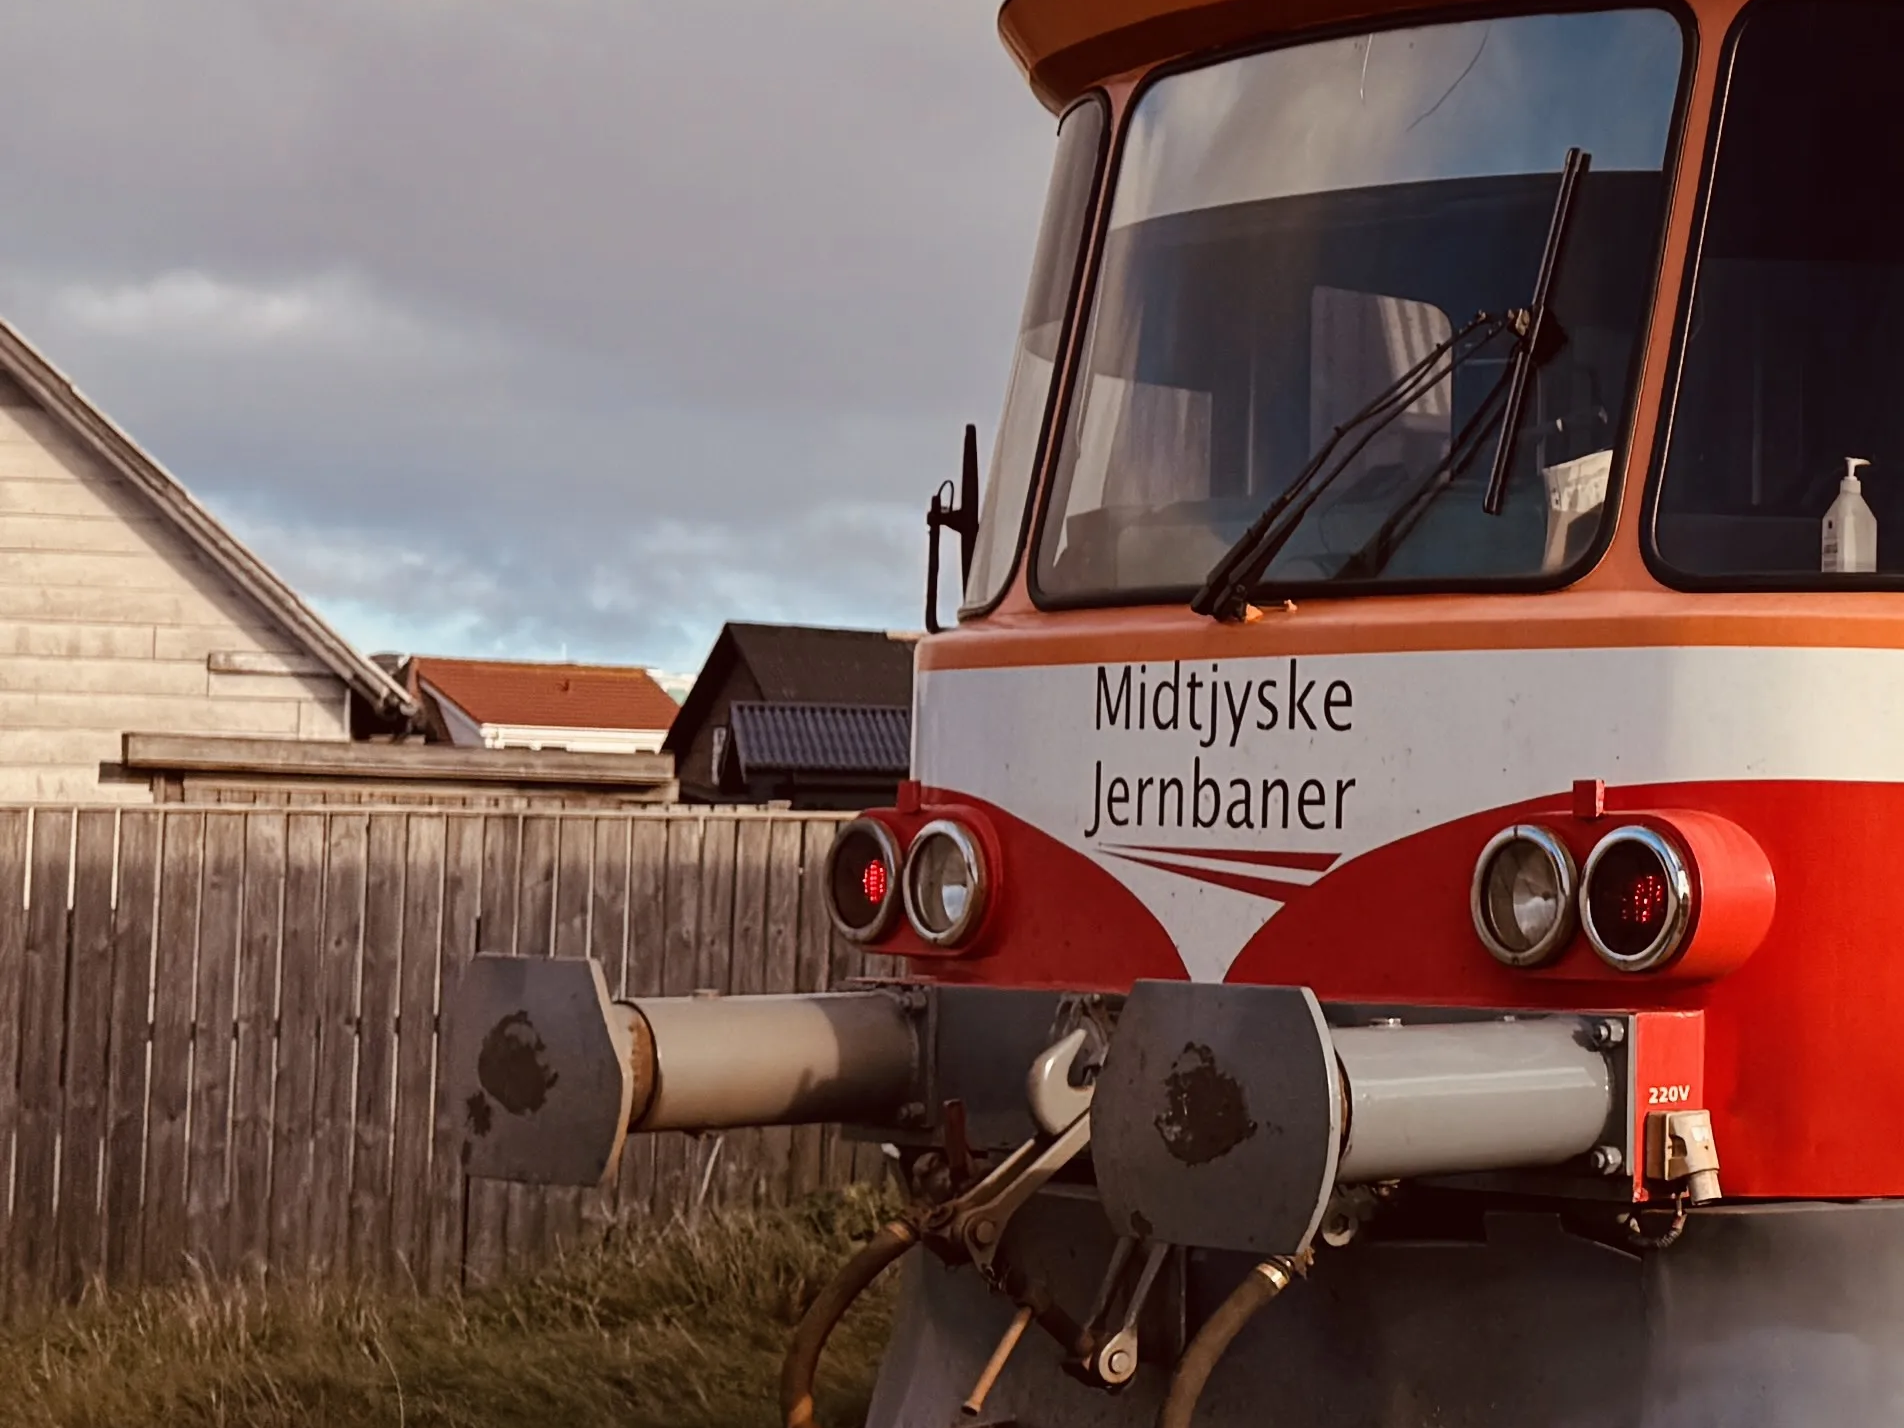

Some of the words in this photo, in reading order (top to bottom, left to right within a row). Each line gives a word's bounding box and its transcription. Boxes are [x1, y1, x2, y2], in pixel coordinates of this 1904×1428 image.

[1096, 658, 1353, 748] Midtjyske
[1084, 756, 1356, 838] Jernbaner
[1648, 1084, 1690, 1104] 220V
